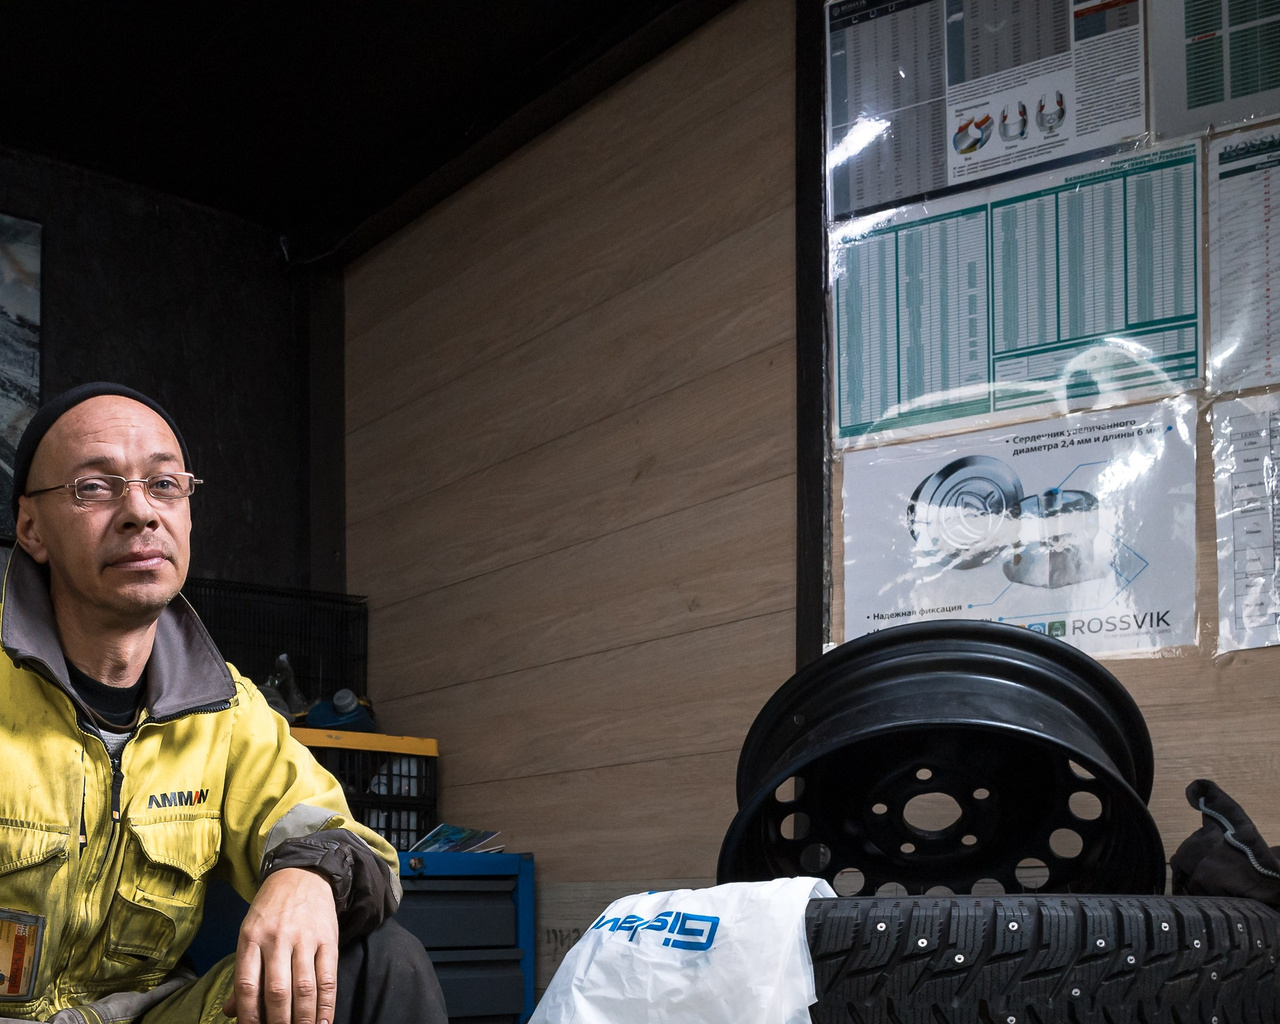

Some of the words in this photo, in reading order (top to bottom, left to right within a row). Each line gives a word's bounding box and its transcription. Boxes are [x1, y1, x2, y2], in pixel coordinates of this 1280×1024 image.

[1223, 134, 1280, 158] ROSSV
[1012, 428, 1065, 445] Сердечник
[1012, 440, 1059, 457] диаметра
[1060, 438, 1075, 449] 2,4
[1076, 437, 1092, 446] мм
[1101, 431, 1135, 443] длины
[1136, 428, 1143, 436] 6
[872, 609, 917, 621] Надежная
[918, 604, 962, 617] фиксация
[1072, 610, 1171, 636] ROSSVIK
[590, 911, 721, 952] Gislav
